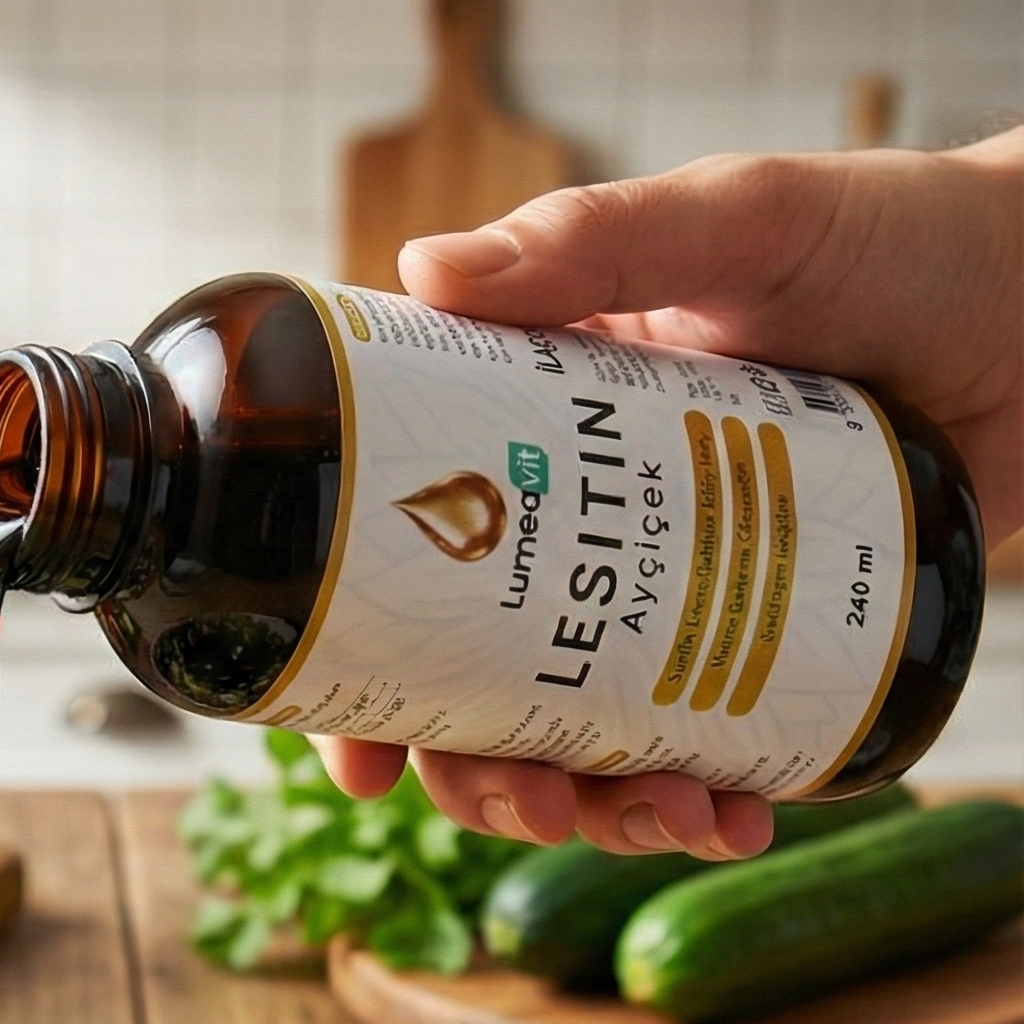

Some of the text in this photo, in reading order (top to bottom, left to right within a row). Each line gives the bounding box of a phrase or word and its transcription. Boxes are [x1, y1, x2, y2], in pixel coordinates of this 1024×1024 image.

[535, 397, 626, 688] LESITIN
[620, 460, 670, 634] Ayçiçek
[846, 545, 873, 628] 240 ml
